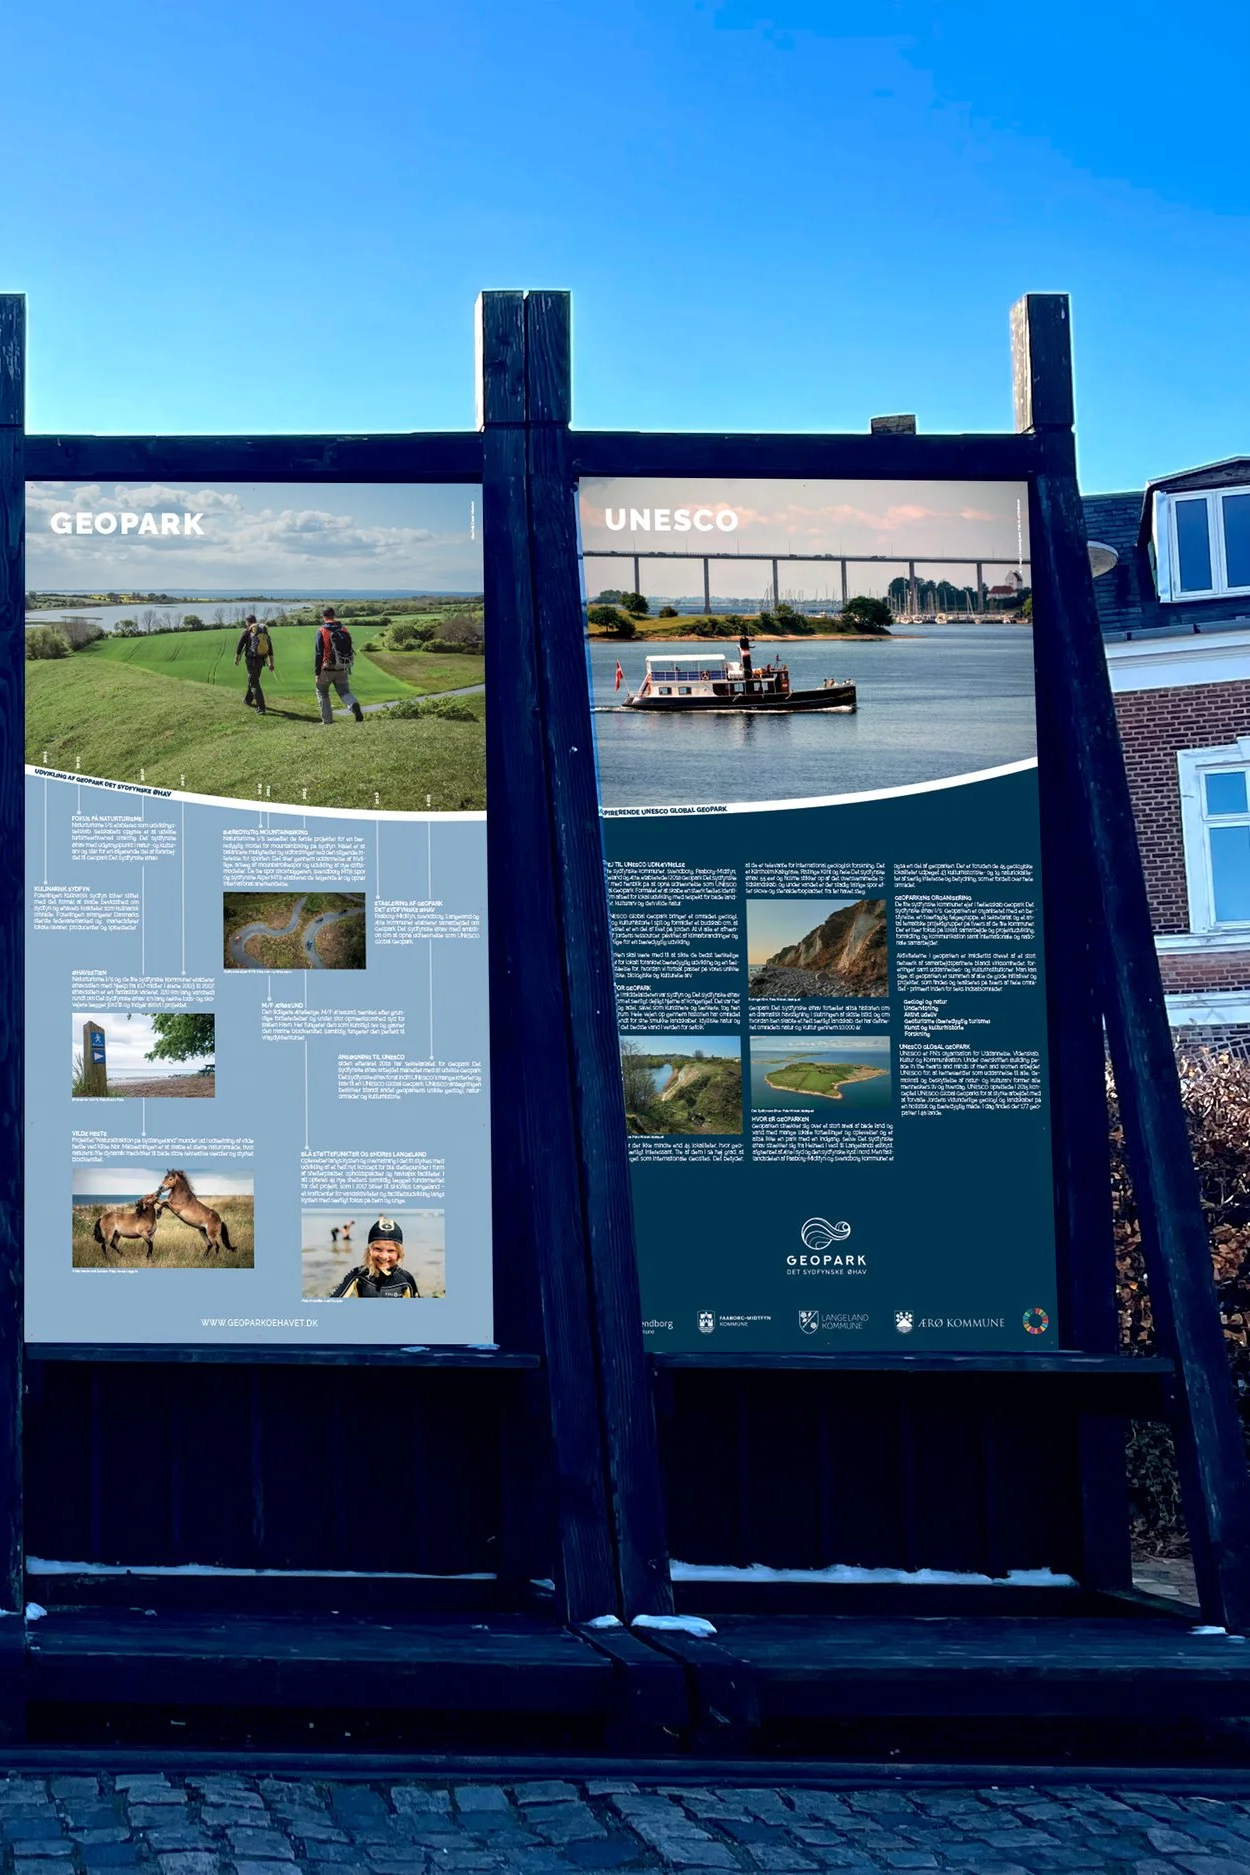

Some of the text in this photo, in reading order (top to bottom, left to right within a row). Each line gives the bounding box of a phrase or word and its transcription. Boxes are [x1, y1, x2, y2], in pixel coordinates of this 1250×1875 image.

[50, 512, 205, 535] GEOPARK
[605, 508, 739, 532] UNESCO
[34, 768, 67, 780] UDVIKLING
[76, 776, 104, 787] GEOPARK
[117, 784, 152, 795] SYDFYNSKE
[152, 789, 172, 798] ØHAV
[786, 1255, 867, 1266] GEOPARK
[200, 1318, 318, 1327] WWW.GEOPARKOEHAVET.DK
[821, 1314, 869, 1322] LANGELAND
[918, 1318, 1005, 1328] ÆRØ KOMMUNE
[821, 1321, 863, 1330] KOMMUNE
